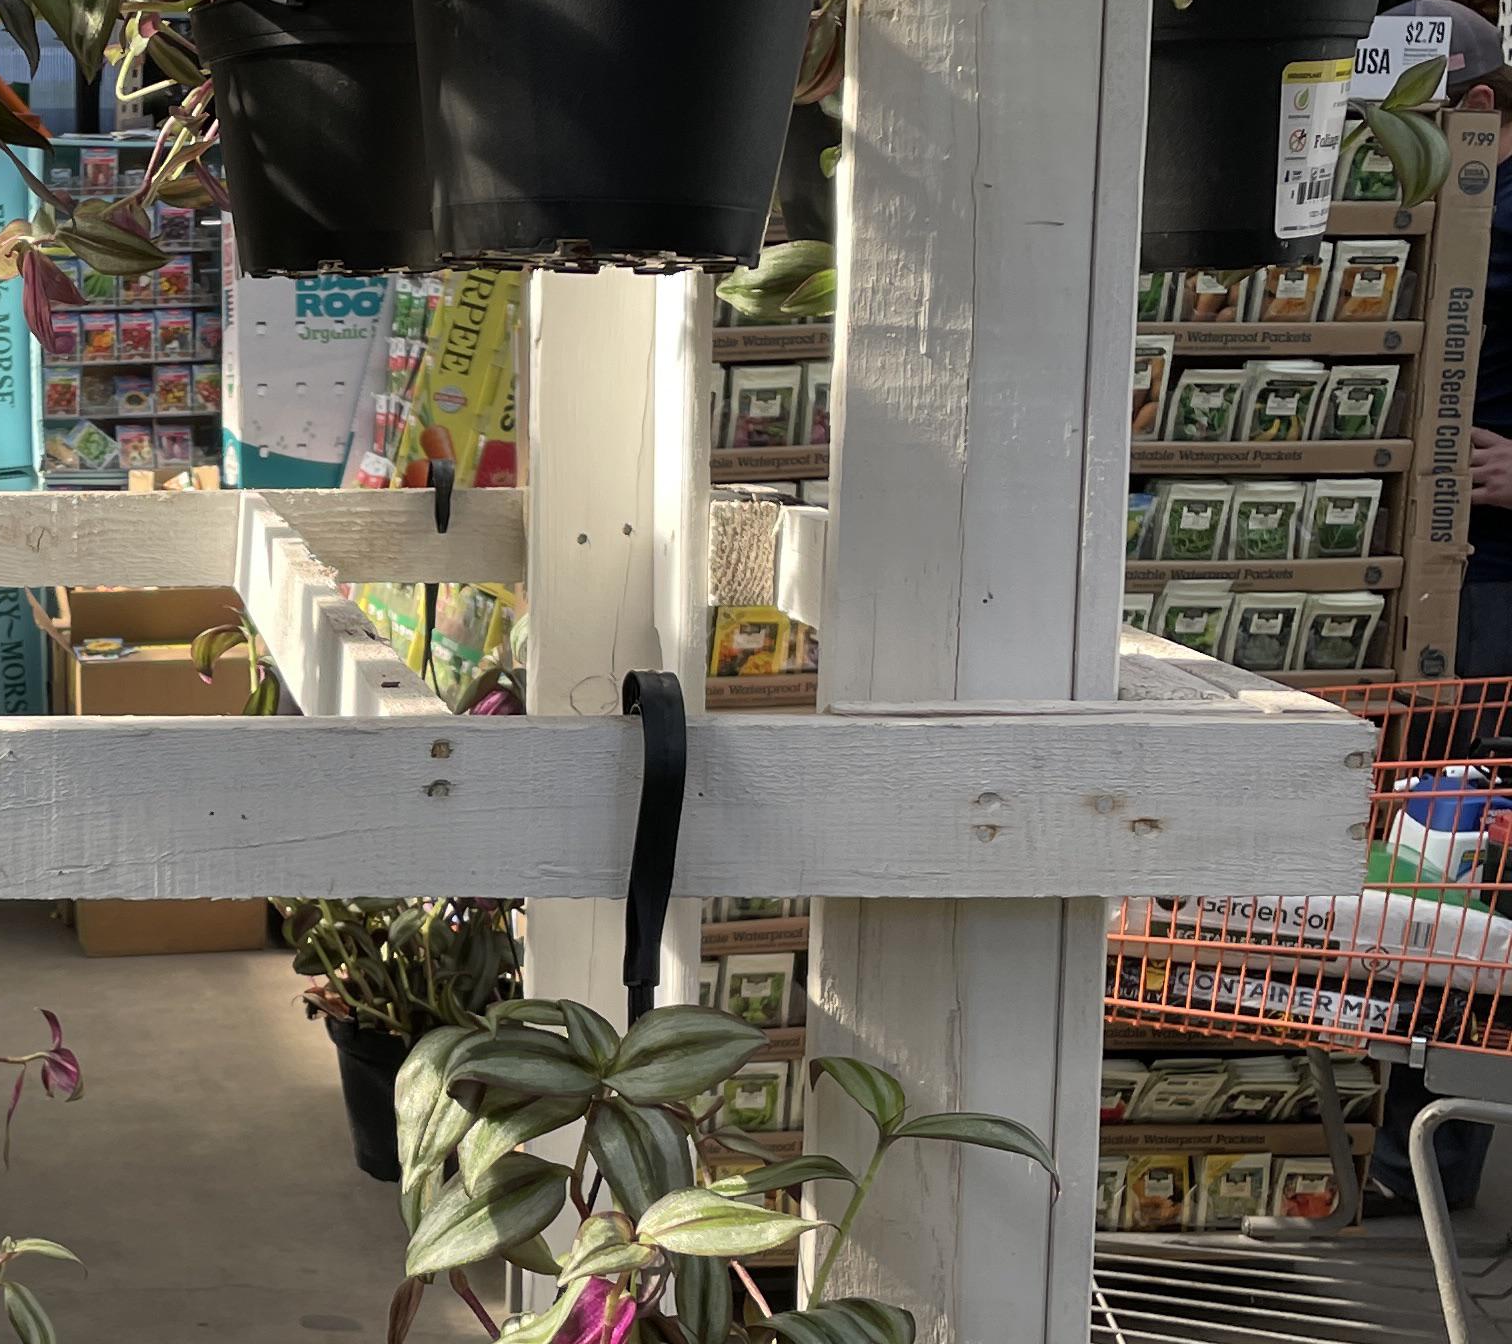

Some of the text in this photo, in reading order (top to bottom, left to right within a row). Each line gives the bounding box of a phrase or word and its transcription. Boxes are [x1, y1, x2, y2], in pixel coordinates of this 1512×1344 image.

[1405, 22, 1445, 45] $2.79
[1355, 48, 1390, 74] USA
[1462, 131, 1495, 146] $7.99
[295, 292, 384, 318] ROO
[439, 269, 500, 376] RPEE
[743, 334, 815, 347] Waterproof
[1188, 331, 1311, 345] Waterproof Packets
[1431, 287, 1474, 543] Garden Seed Collections
[738, 455, 809, 468] Waterproof
[1179, 449, 1250, 464] Waterproof
[1254, 449, 1303, 461] Packets
[1244, 568, 1294, 580] Packets
[1197, 897, 1287, 924] Garden
[733, 928, 804, 943] Waterproof
[1178, 970, 1389, 1023] CONTAINER MIX
